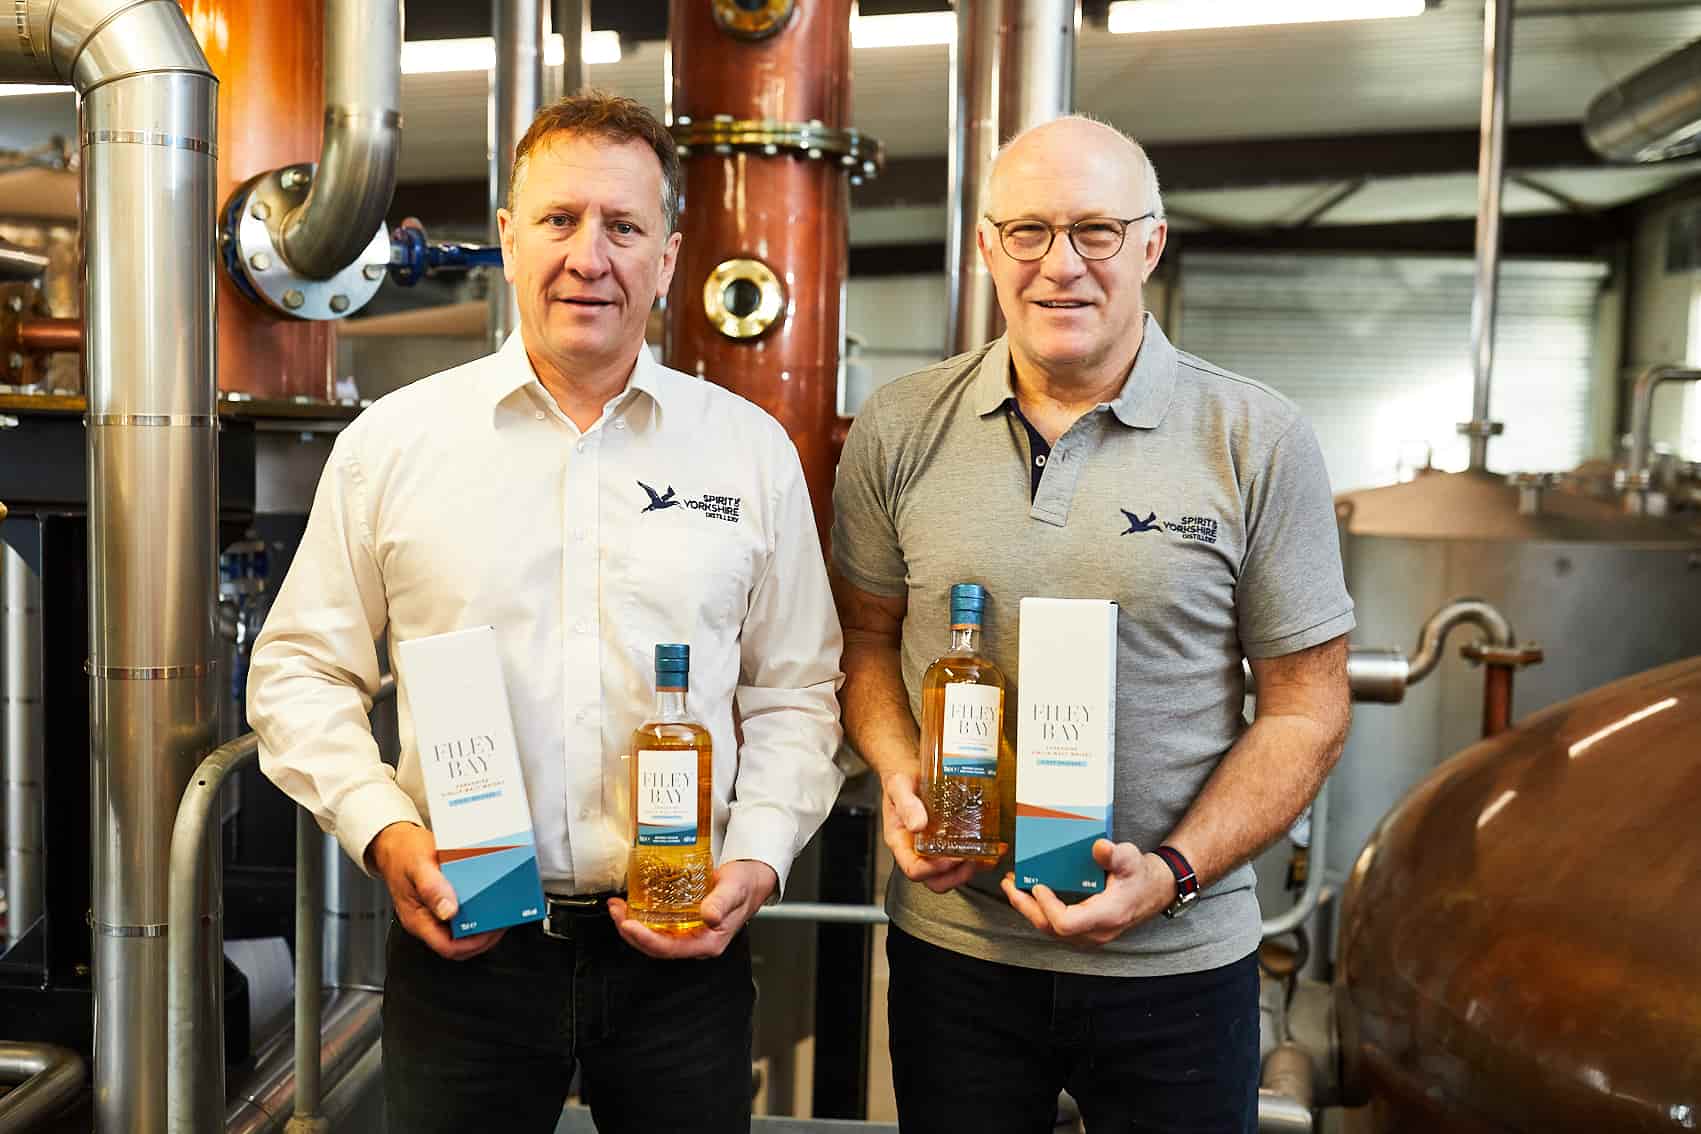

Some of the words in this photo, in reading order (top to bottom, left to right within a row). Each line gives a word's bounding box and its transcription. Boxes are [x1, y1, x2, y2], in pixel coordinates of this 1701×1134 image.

[683, 499, 740, 517] YORKSHIRE
[703, 494, 733, 506] SPIRIT
[1163, 520, 1217, 537] YORKSHIRE
[1182, 516, 1211, 527] SPIRIT
[951, 703, 997, 721] FILEY
[1032, 703, 1093, 722] FILEY
[959, 721, 991, 737] BAY
[1042, 723, 1082, 741] BAY
[433, 735, 496, 762] FILEY
[447, 756, 489, 780] BAY
[641, 771, 690, 788] FILEY
[649, 788, 683, 804] BAY
